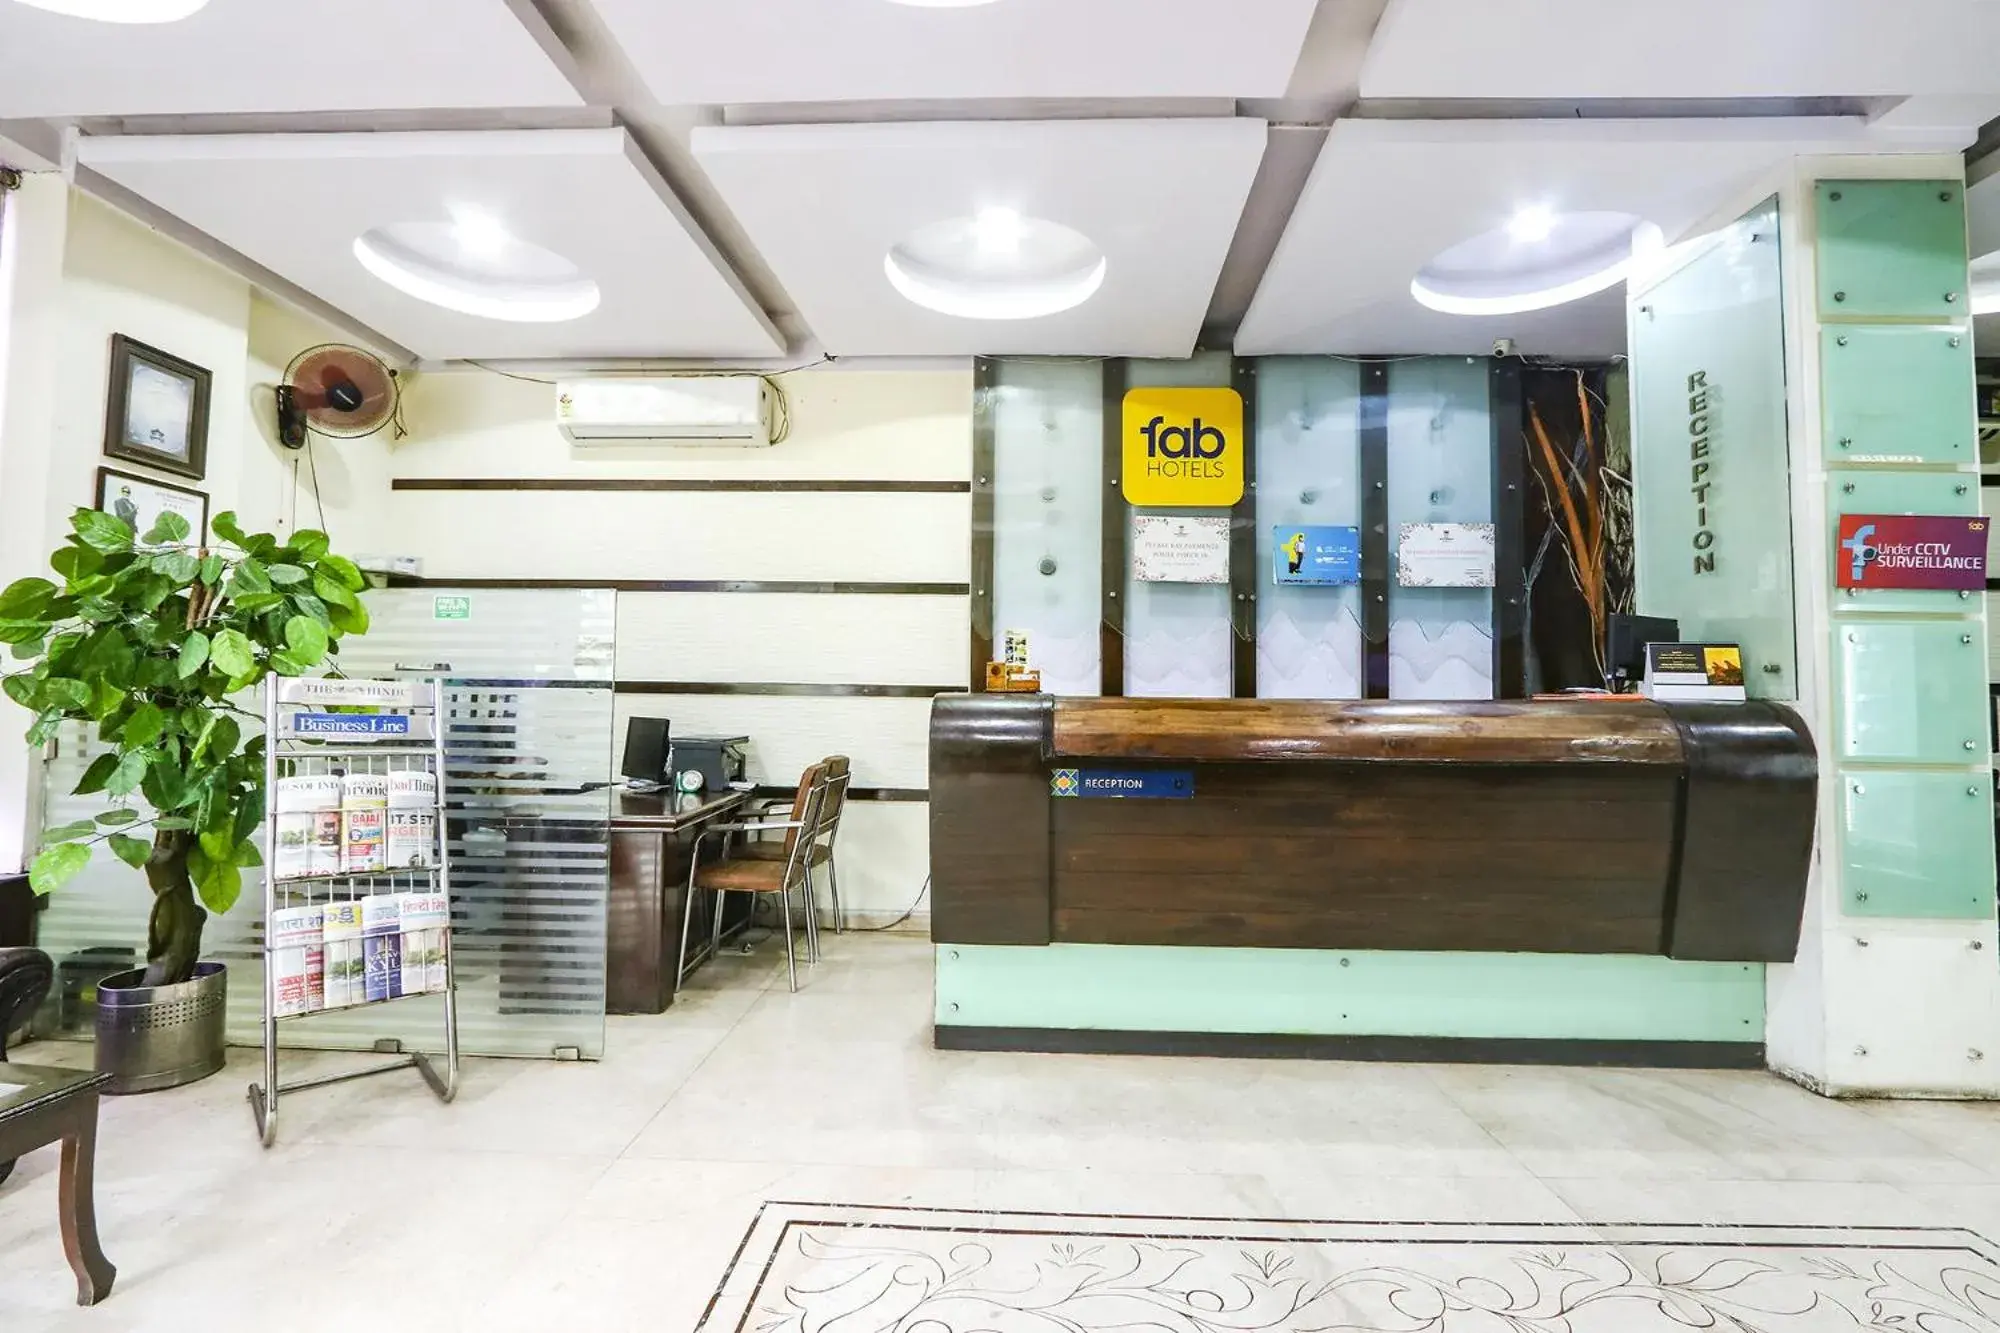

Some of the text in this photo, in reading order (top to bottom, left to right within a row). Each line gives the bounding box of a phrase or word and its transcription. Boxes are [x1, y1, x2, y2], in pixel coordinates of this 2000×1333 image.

[1140, 416, 1226, 459] fab
[1147, 461, 1225, 478] HOTELS
[1687, 369, 1715, 575] RECEPTION
[1968, 520, 1985, 532] fab
[1877, 543, 1951, 555] Under CCTV
[1877, 556, 1983, 569] SURVEILLANCE
[300, 717, 405, 733] Business Line
[1084, 779, 1143, 789] RECEPTION
[409, 814, 434, 825] SET
